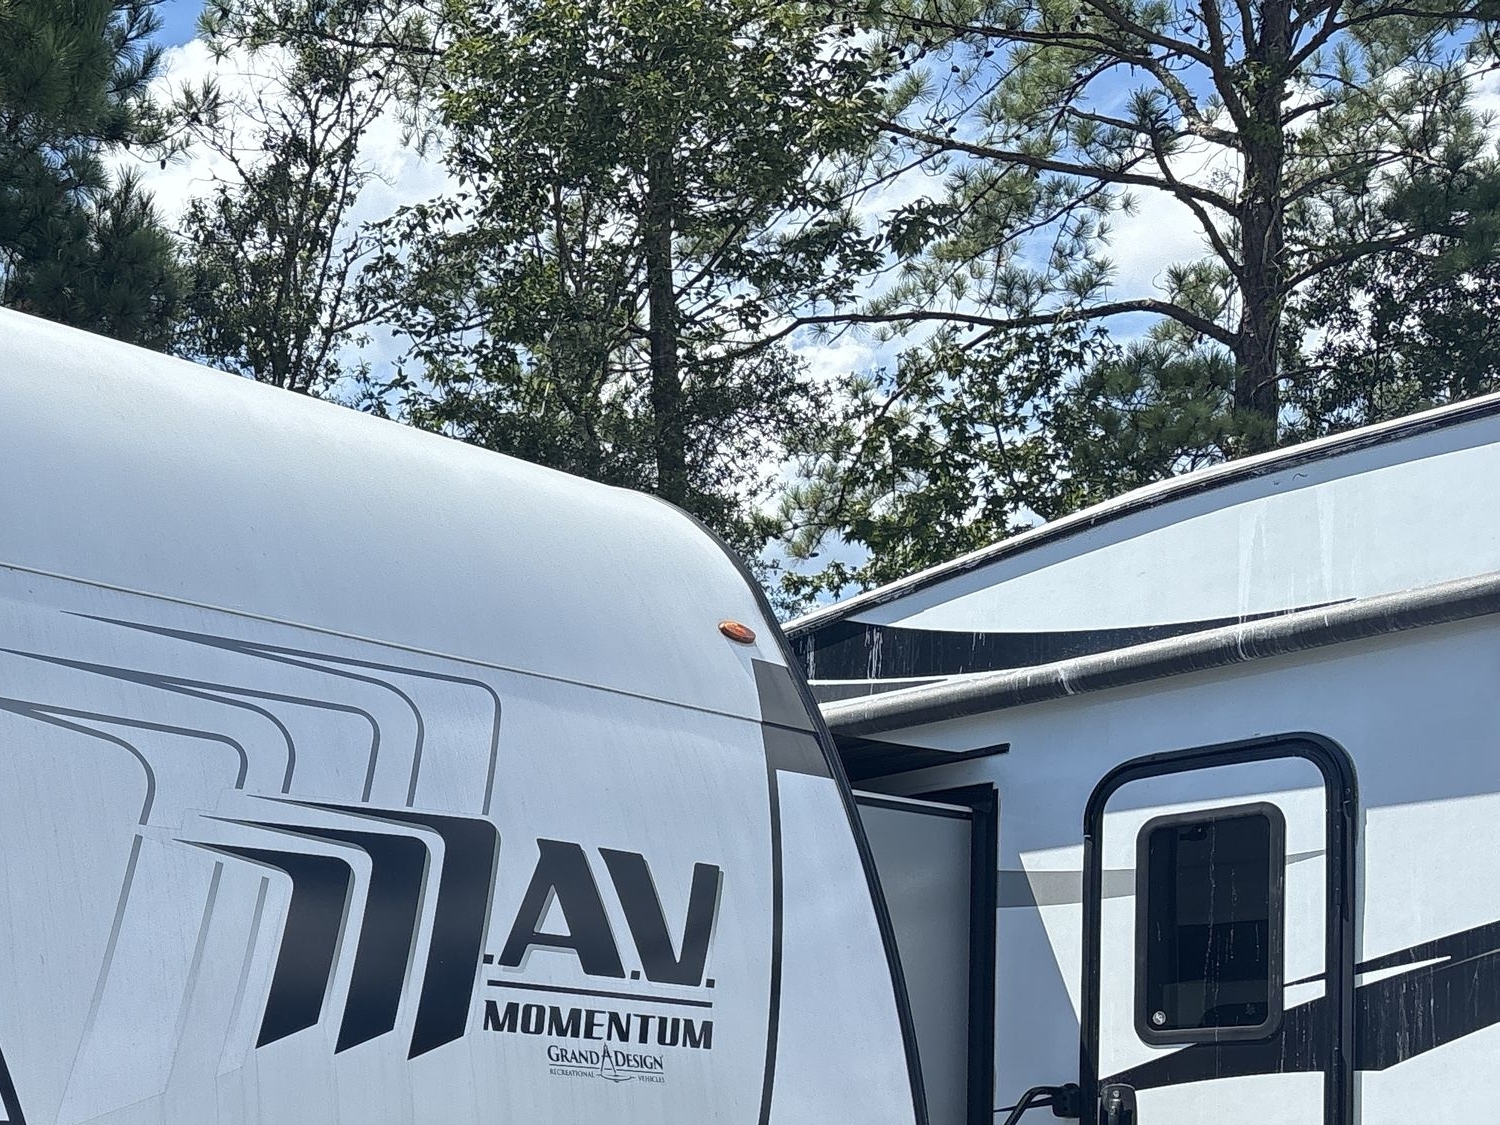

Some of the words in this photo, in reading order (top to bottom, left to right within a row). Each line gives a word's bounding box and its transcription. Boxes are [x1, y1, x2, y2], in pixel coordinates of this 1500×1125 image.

[483, 1000, 713, 1050] MOMENTUM
[547, 1045, 600, 1065] GRAND
[613, 1050, 664, 1070] DESIGN
[550, 1068, 595, 1078] RECREATIONAL
